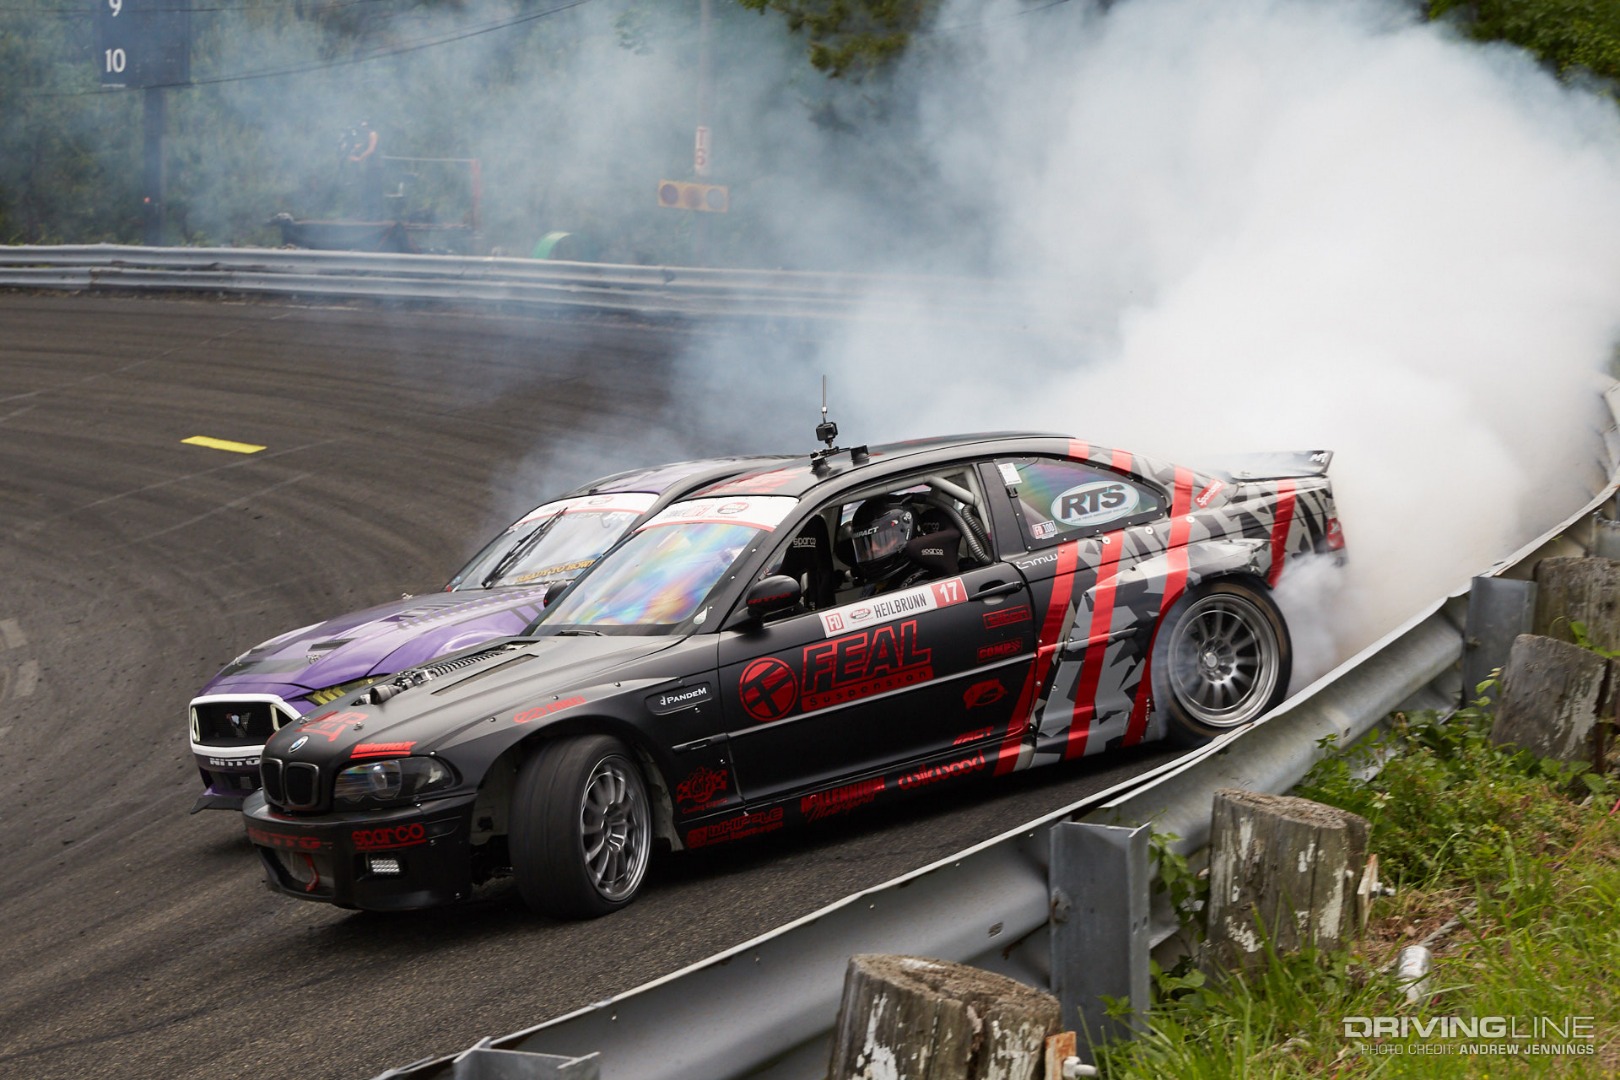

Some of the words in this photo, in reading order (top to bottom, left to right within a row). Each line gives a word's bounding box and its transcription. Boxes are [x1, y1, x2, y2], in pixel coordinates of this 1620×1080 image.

[109, 0, 122, 17] 9
[105, 48, 126, 73] 10
[1061, 484, 1128, 520] RTS
[873, 592, 927, 619] HEILBRUNN
[939, 582, 958, 603] 17
[801, 620, 932, 695] FEAL
[809, 671, 927, 708] Suspension
[209, 757, 261, 767] NITTO
[352, 823, 425, 847] sparco
